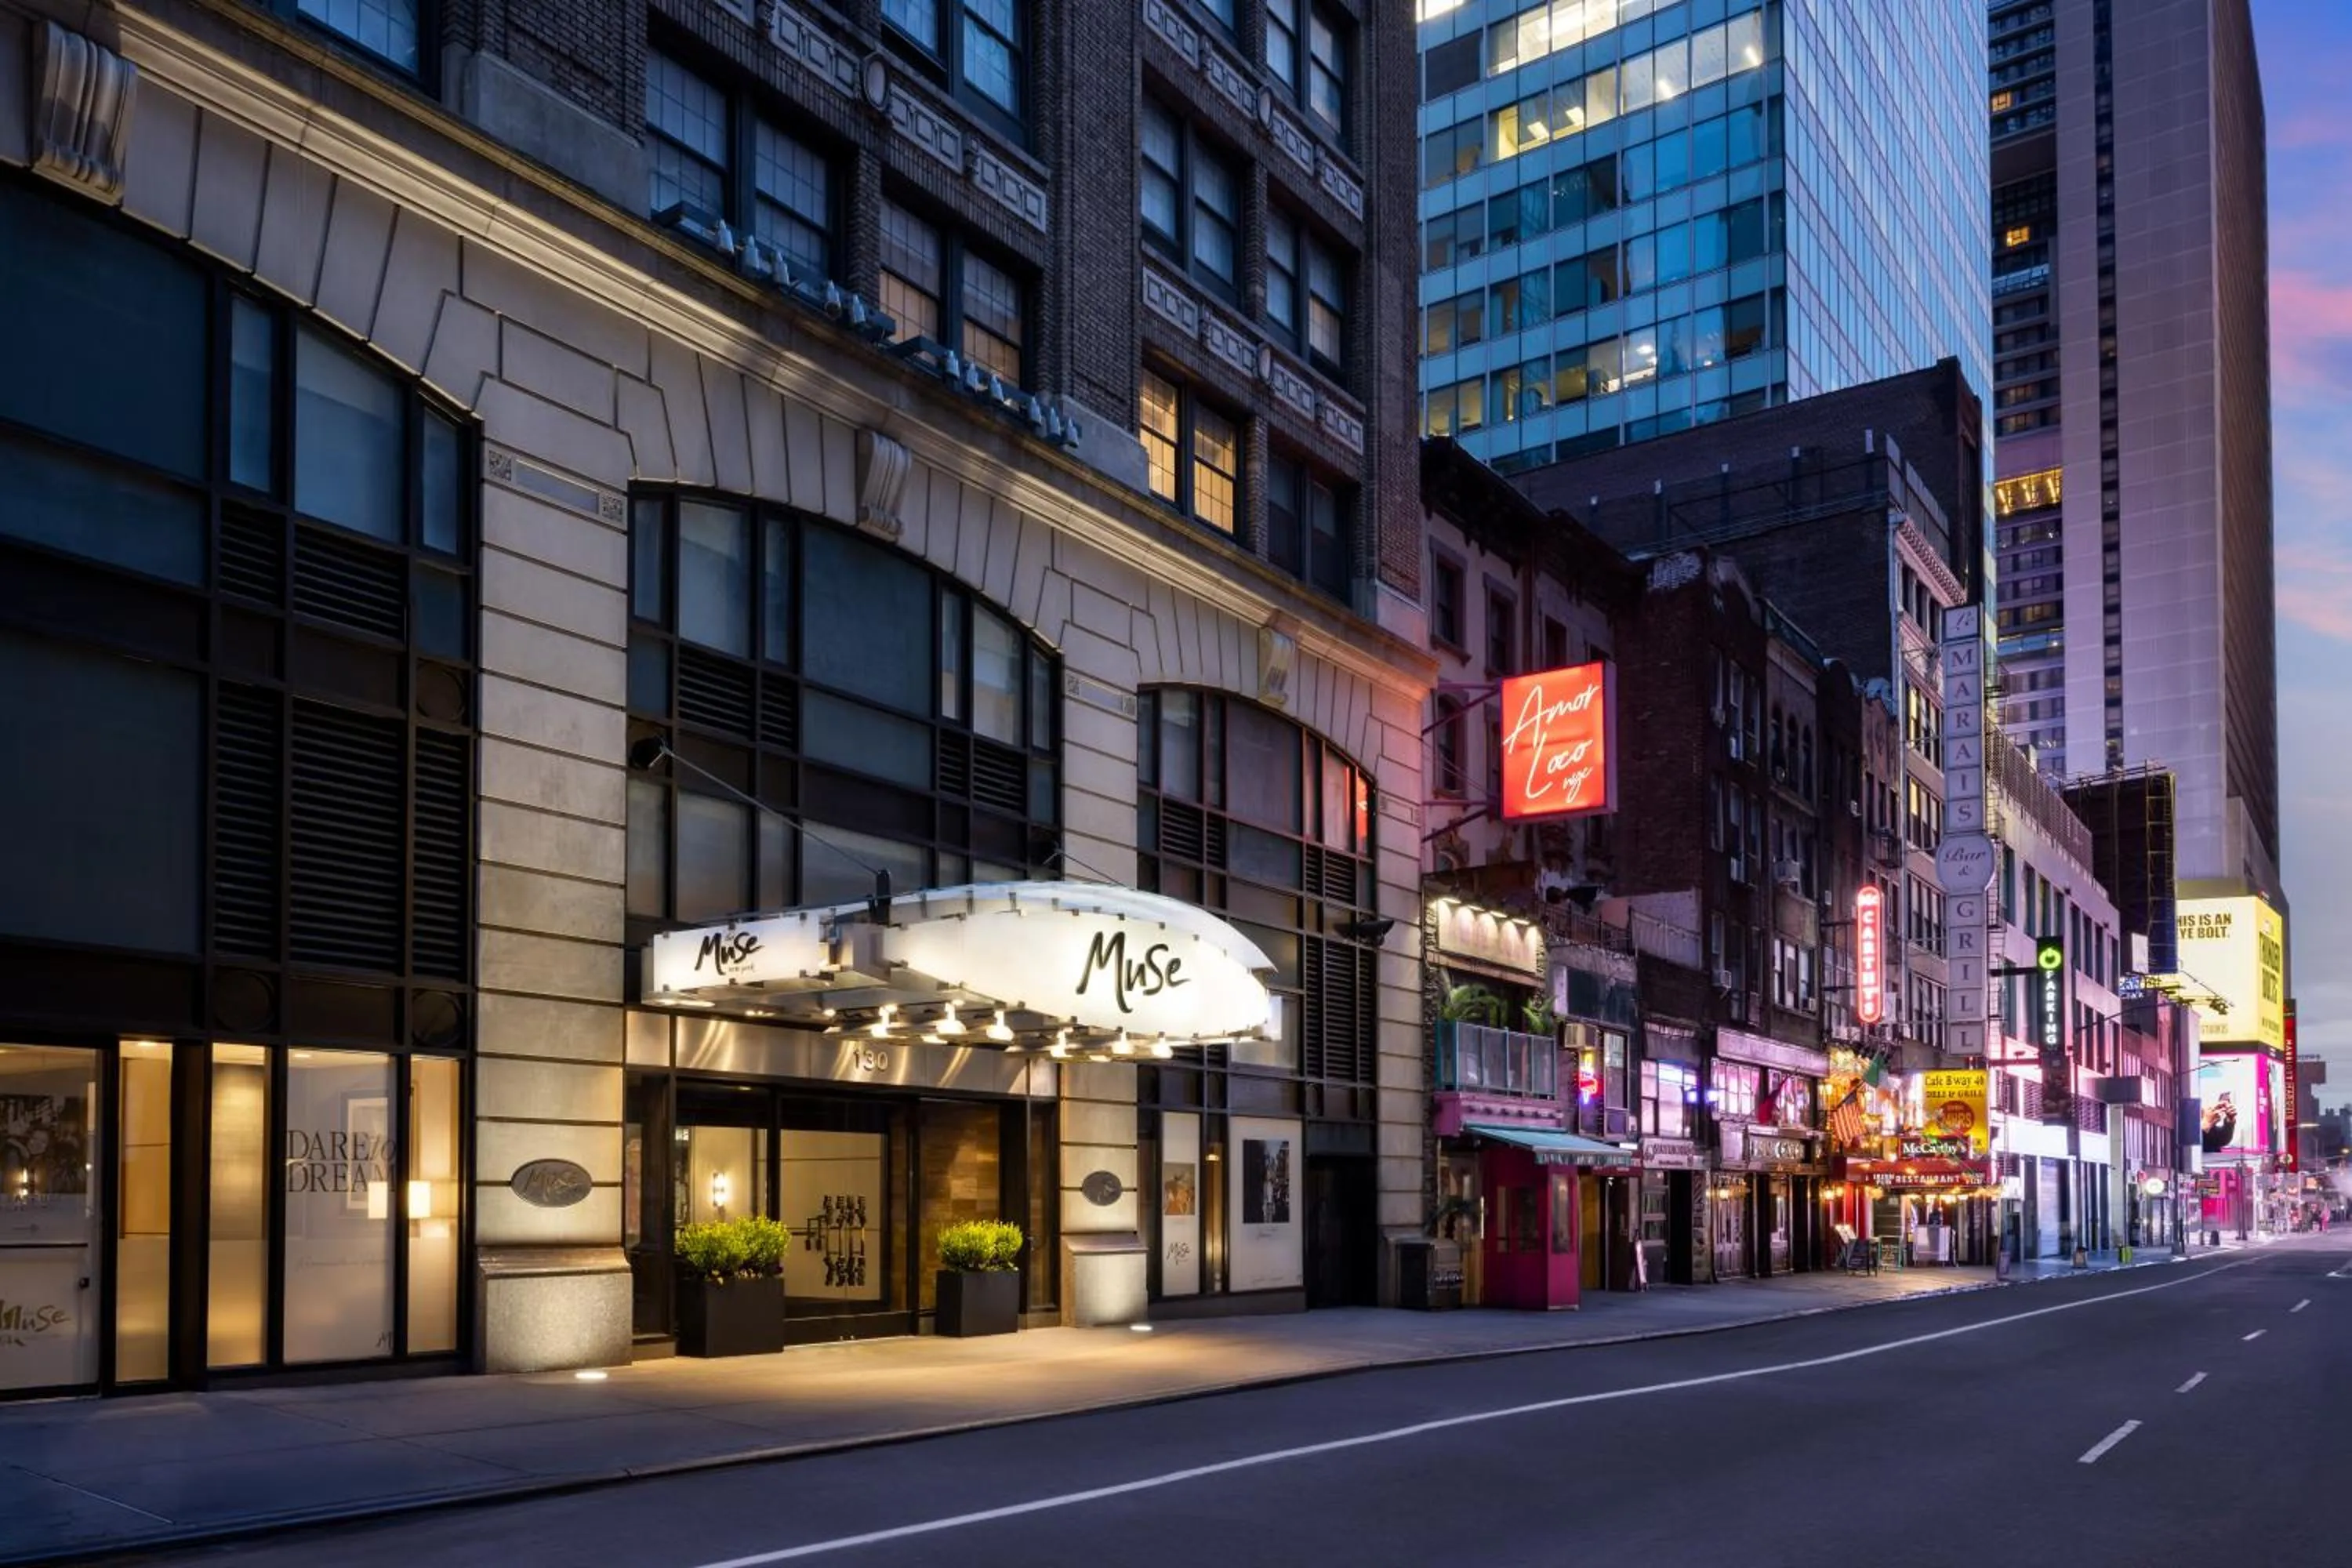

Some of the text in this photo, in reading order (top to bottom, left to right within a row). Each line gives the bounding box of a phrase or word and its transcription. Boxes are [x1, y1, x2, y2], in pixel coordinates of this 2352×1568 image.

[1503, 684, 1600, 755] Amor
[1951, 648, 1974, 822] MARAIS
[1526, 731, 1594, 800] Loco
[1943, 847, 1987, 864] Bar
[1958, 865, 1971, 877] &
[2176, 913, 2232, 927] HIS IS AN
[2177, 926, 2230, 939] YE BOLT.
[1956, 900, 1975, 1047] GRILL
[2045, 970, 2058, 1045] PARKING
[853, 1050, 888, 1071] 130
[288, 1129, 369, 1161] DARE
[288, 1162, 396, 1192] DREAM
[1895, 1174, 1960, 1184] RESTAURANT
